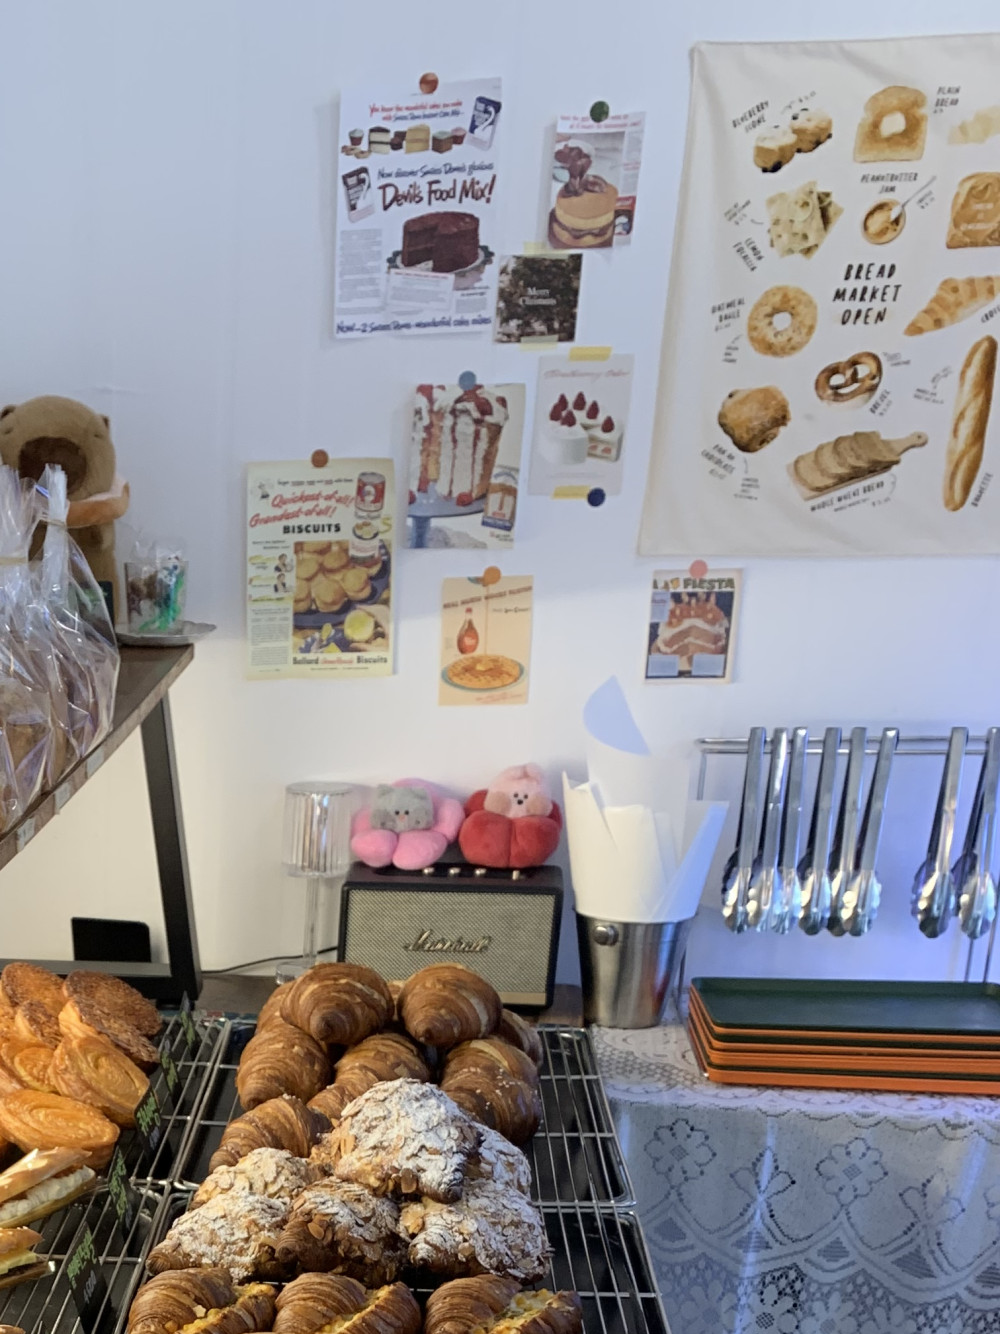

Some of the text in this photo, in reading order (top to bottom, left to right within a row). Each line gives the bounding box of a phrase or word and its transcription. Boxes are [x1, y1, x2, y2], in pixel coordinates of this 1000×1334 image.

[732, 100, 769, 128] BLUEBERRY
[377, 174, 496, 211] Devil's Food Mix!
[844, 263, 896, 280] BREAD
[832, 284, 902, 302] MARKET
[841, 307, 887, 326] OPEN
[282, 523, 341, 534] BISCUITS
